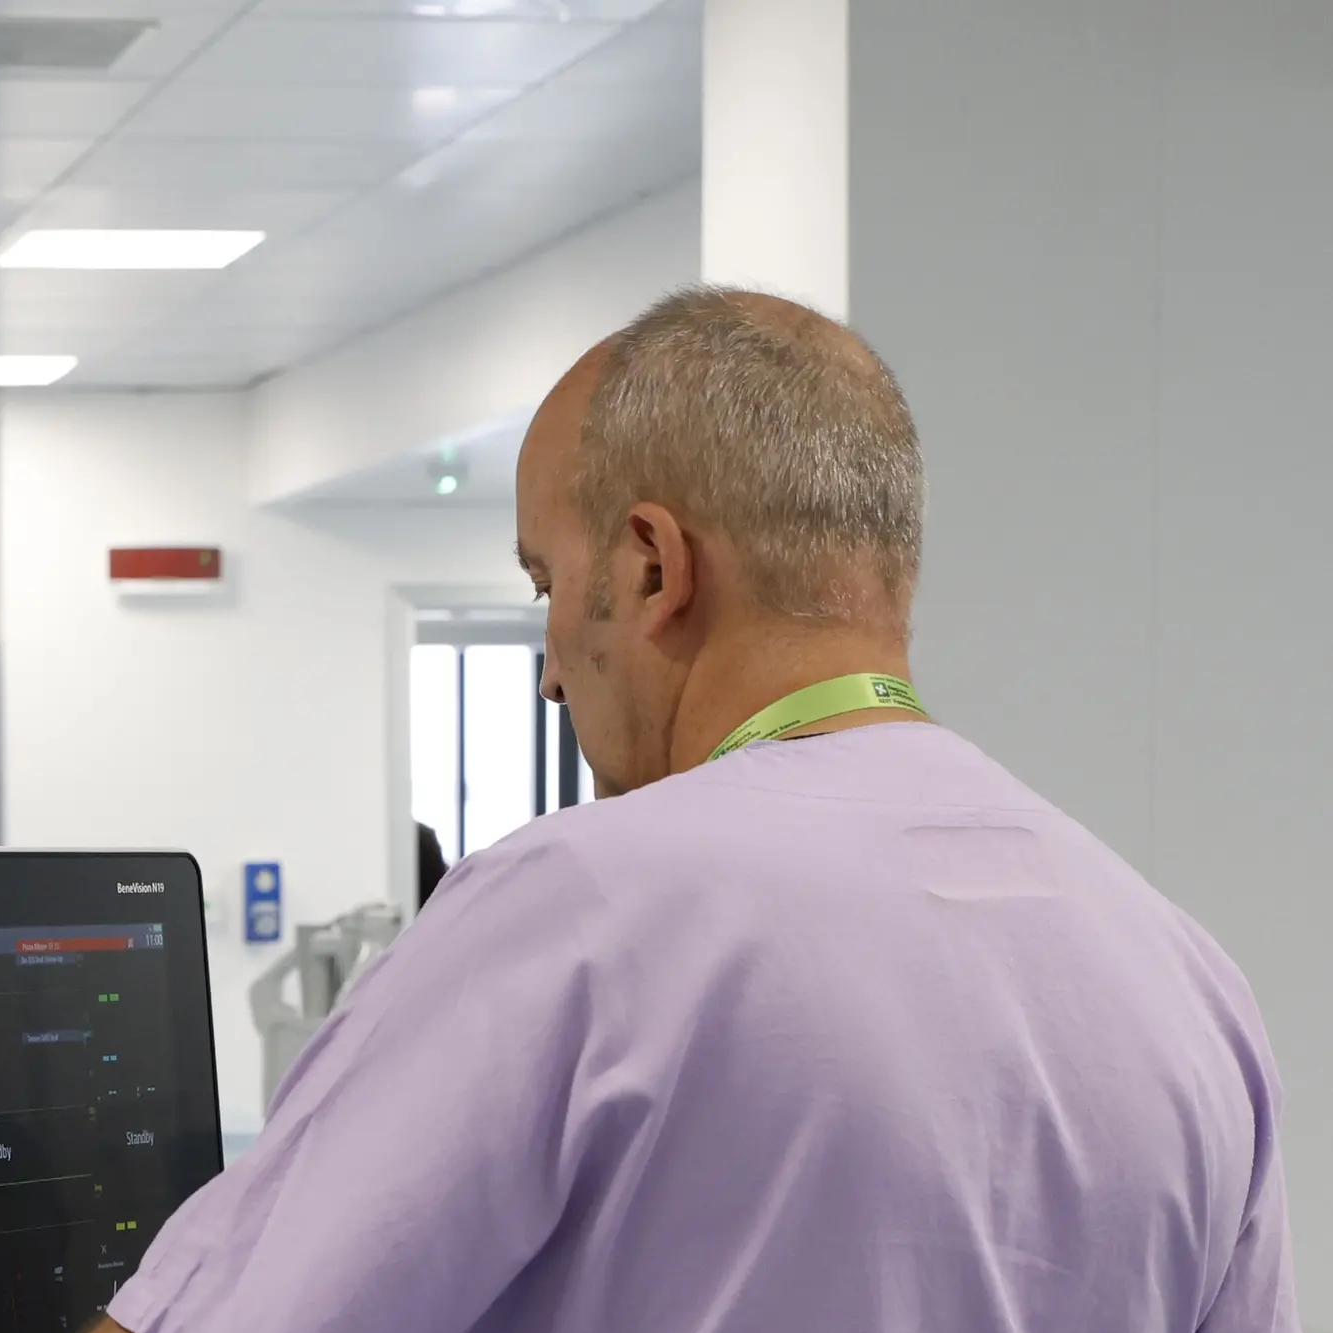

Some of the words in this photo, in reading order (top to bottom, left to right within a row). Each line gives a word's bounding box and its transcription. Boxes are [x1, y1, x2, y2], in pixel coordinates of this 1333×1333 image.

[117, 882, 152, 894] BeneVision
[152, 882, 165, 893] N19
[126, 1130, 155, 1146] Standby
